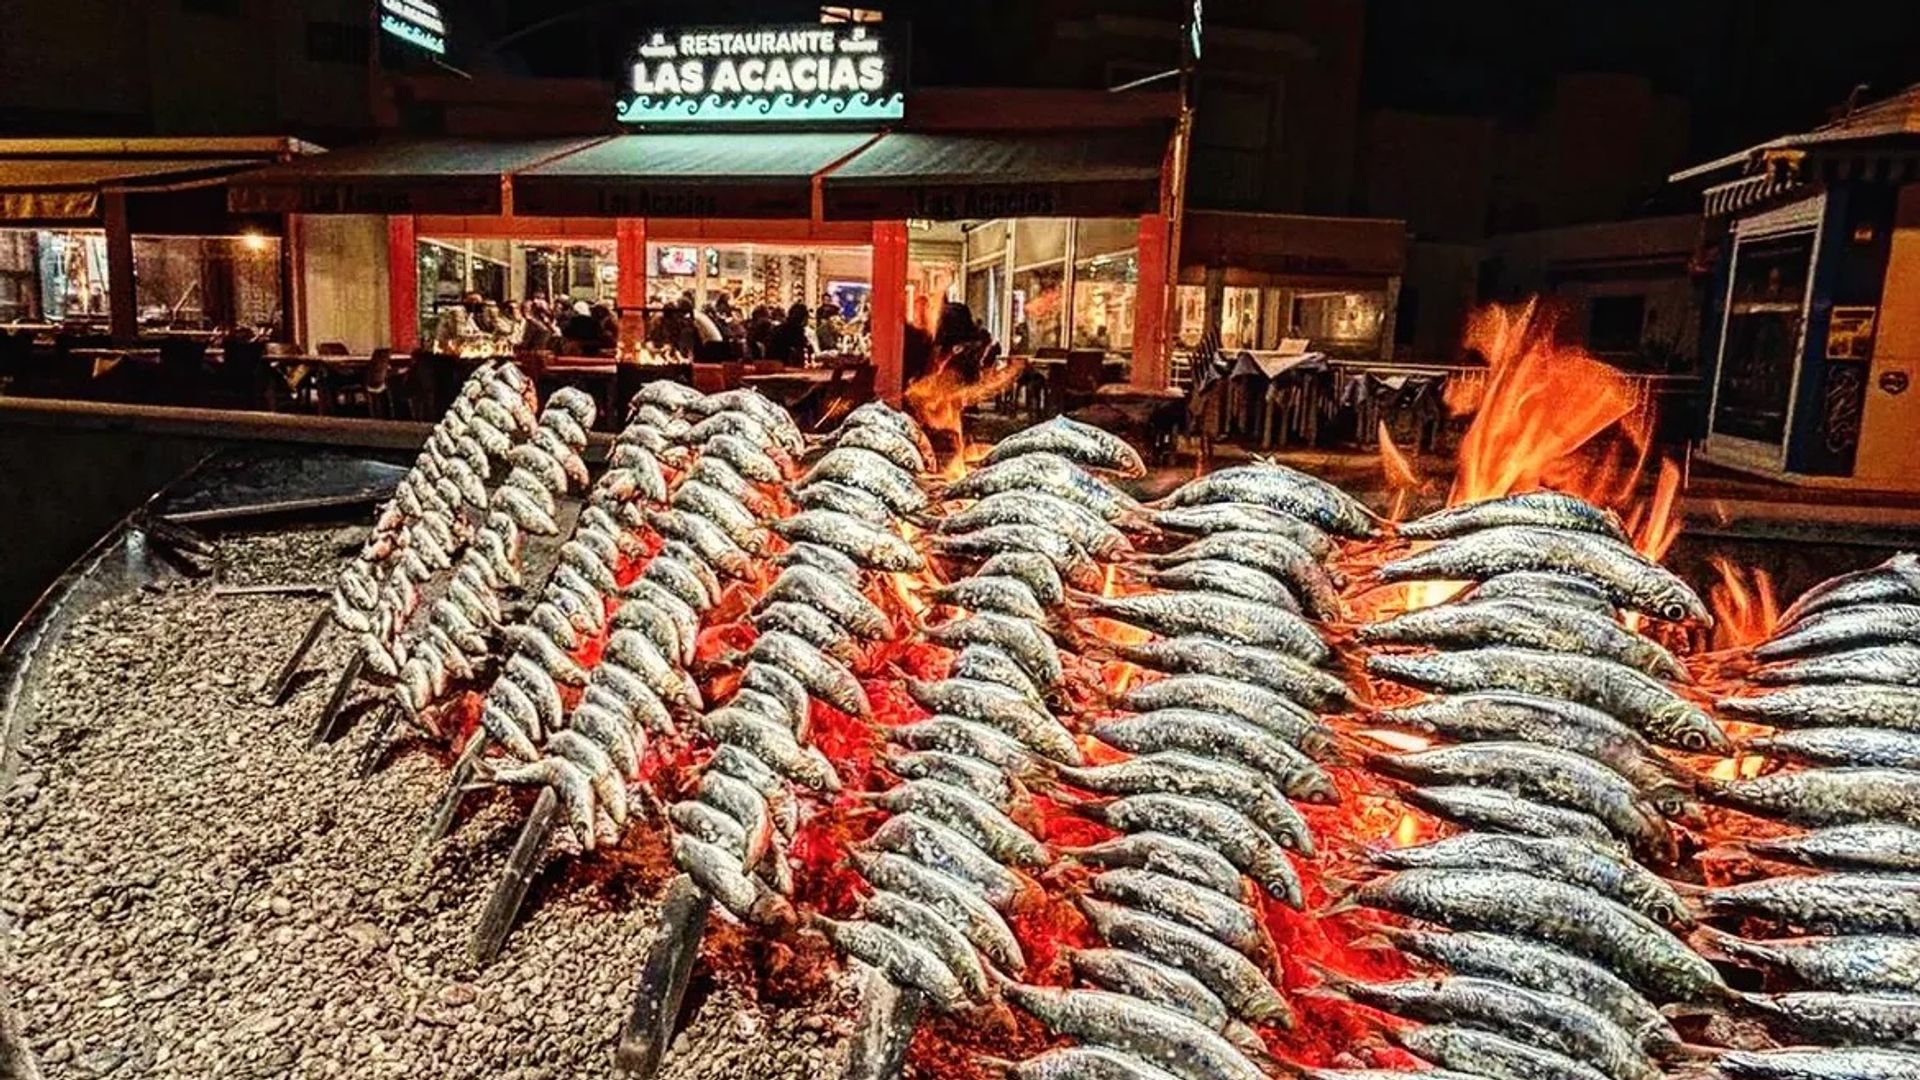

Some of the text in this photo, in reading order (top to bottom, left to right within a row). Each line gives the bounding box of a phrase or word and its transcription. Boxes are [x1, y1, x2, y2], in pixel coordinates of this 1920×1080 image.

[680, 31, 835, 55] RESTAURANTE
[633, 58, 886, 94] LAS ACACIAS
